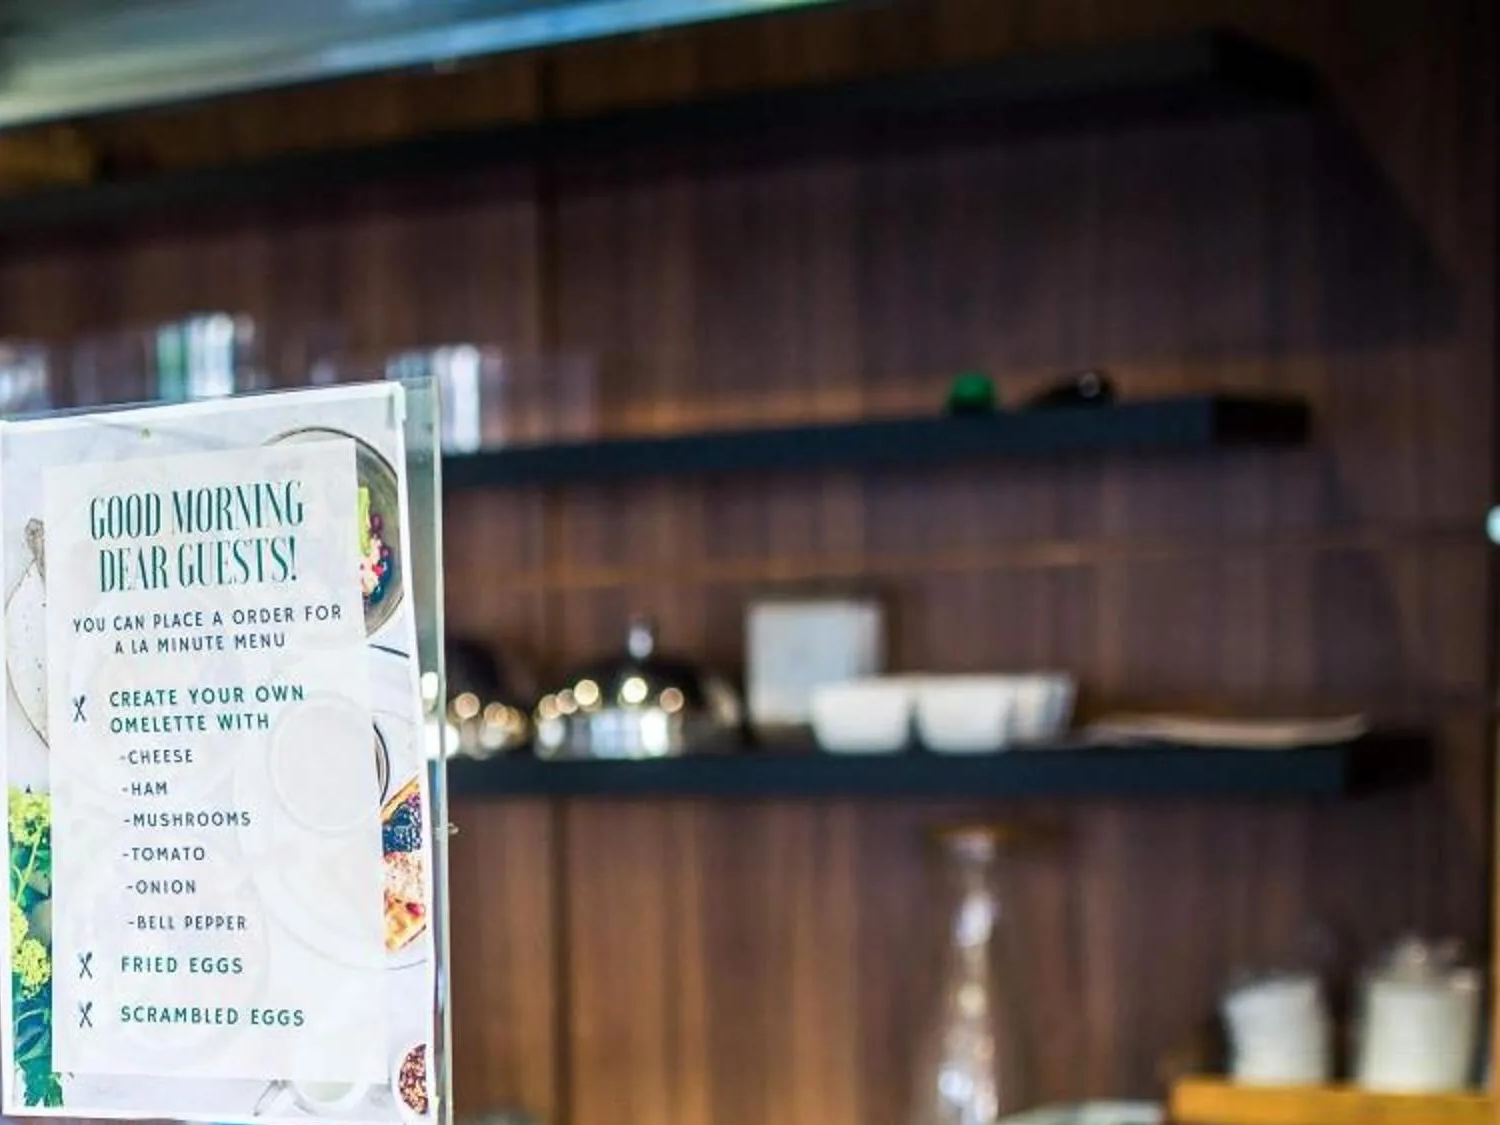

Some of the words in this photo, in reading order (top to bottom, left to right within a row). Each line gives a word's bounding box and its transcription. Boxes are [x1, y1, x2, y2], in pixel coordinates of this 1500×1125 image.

[90, 492, 162, 541] GOOD
[171, 479, 304, 534] MORNING
[100, 545, 170, 593] DEAR
[177, 535, 297, 589] GUESTS!
[72, 616, 106, 634] YOU
[112, 614, 146, 632] CAN
[152, 611, 204, 630] PLACE
[211, 610, 224, 626] A
[231, 606, 295, 625] ORDER
[304, 603, 341, 622] FOR
[114, 640, 125, 655] A
[131, 638, 149, 655] LA
[157, 634, 225, 654] MINUTE
[233, 632, 285, 651] MENU
[109, 688, 178, 708] CREATE
[187, 686, 245, 705] YOUR
[254, 684, 305, 703] OWN
[109, 714, 207, 735] OMELETTE
[216, 712, 269, 732] WITH
[119, 748, 193, 766] -CHEESE
[121, 781, 168, 797] -HAM
[123, 810, 252, 828] -MUSHROOMS
[122, 846, 206, 862] -TOMATO
[126, 879, 197, 895] -ONION
[127, 915, 175, 931] -BELL
[183, 914, 246, 931] PEPPER
[120, 955, 179, 974] FRIED
[188, 956, 244, 975] EGGS
[120, 1004, 239, 1026] SCRAMBLED
[250, 1007, 305, 1028] EGGS
